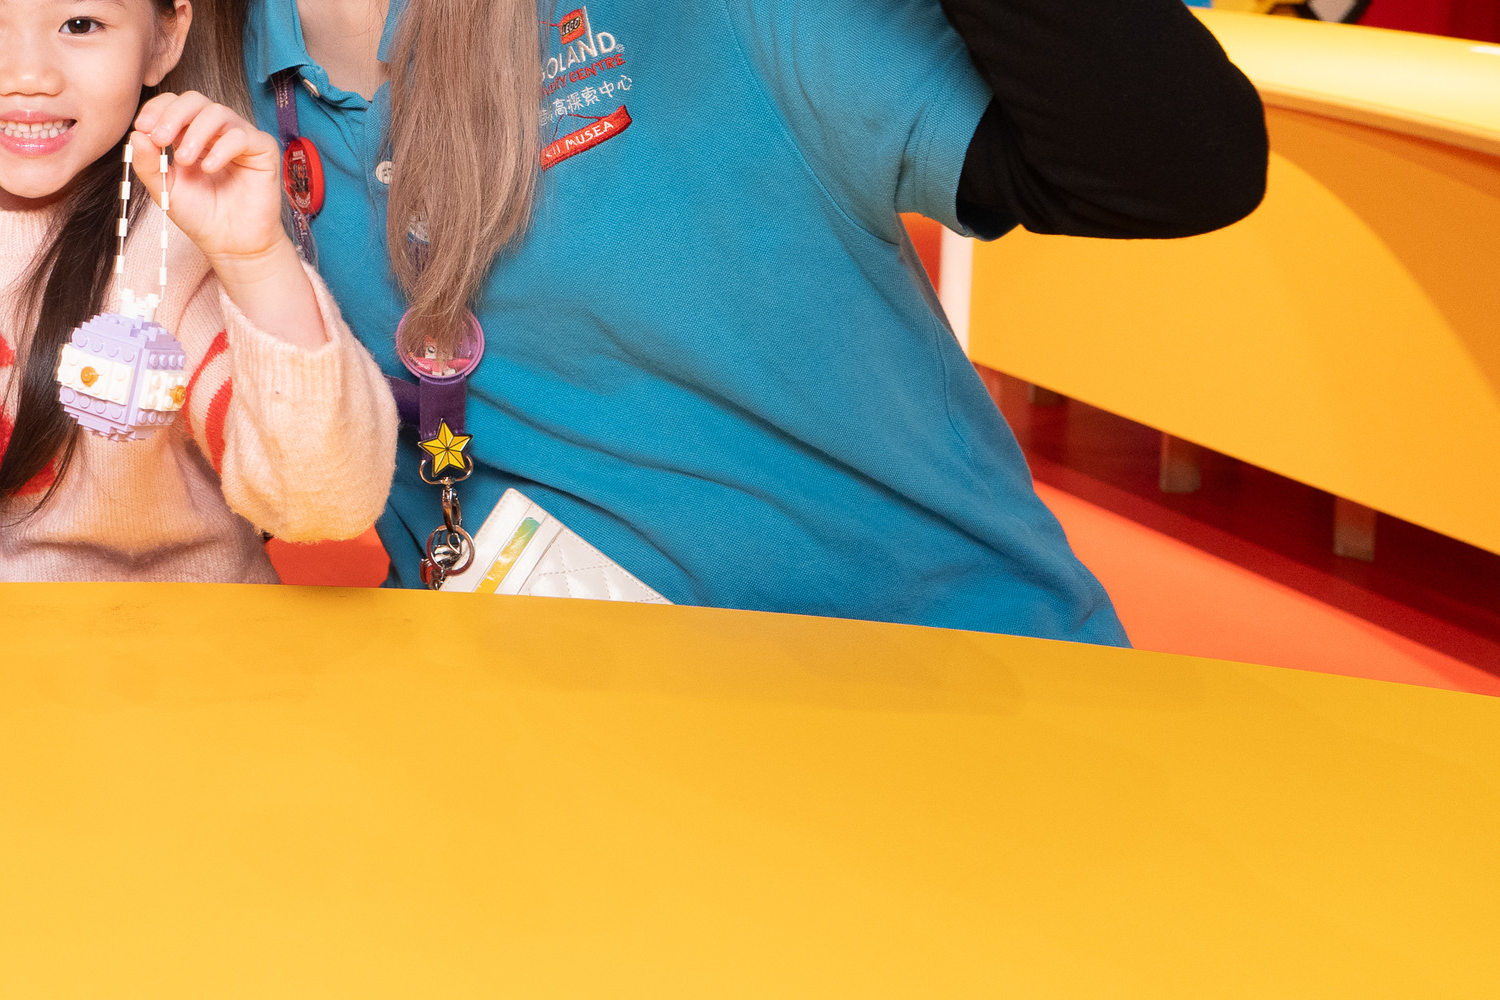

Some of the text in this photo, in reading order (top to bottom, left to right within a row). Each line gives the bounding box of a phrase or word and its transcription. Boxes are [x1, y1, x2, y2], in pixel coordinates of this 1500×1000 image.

[561, 16, 582, 36] LEGO
[540, 31, 617, 81] OLAND
[569, 53, 626, 83] CENTRE
[565, 121, 614, 150] MUSEA
